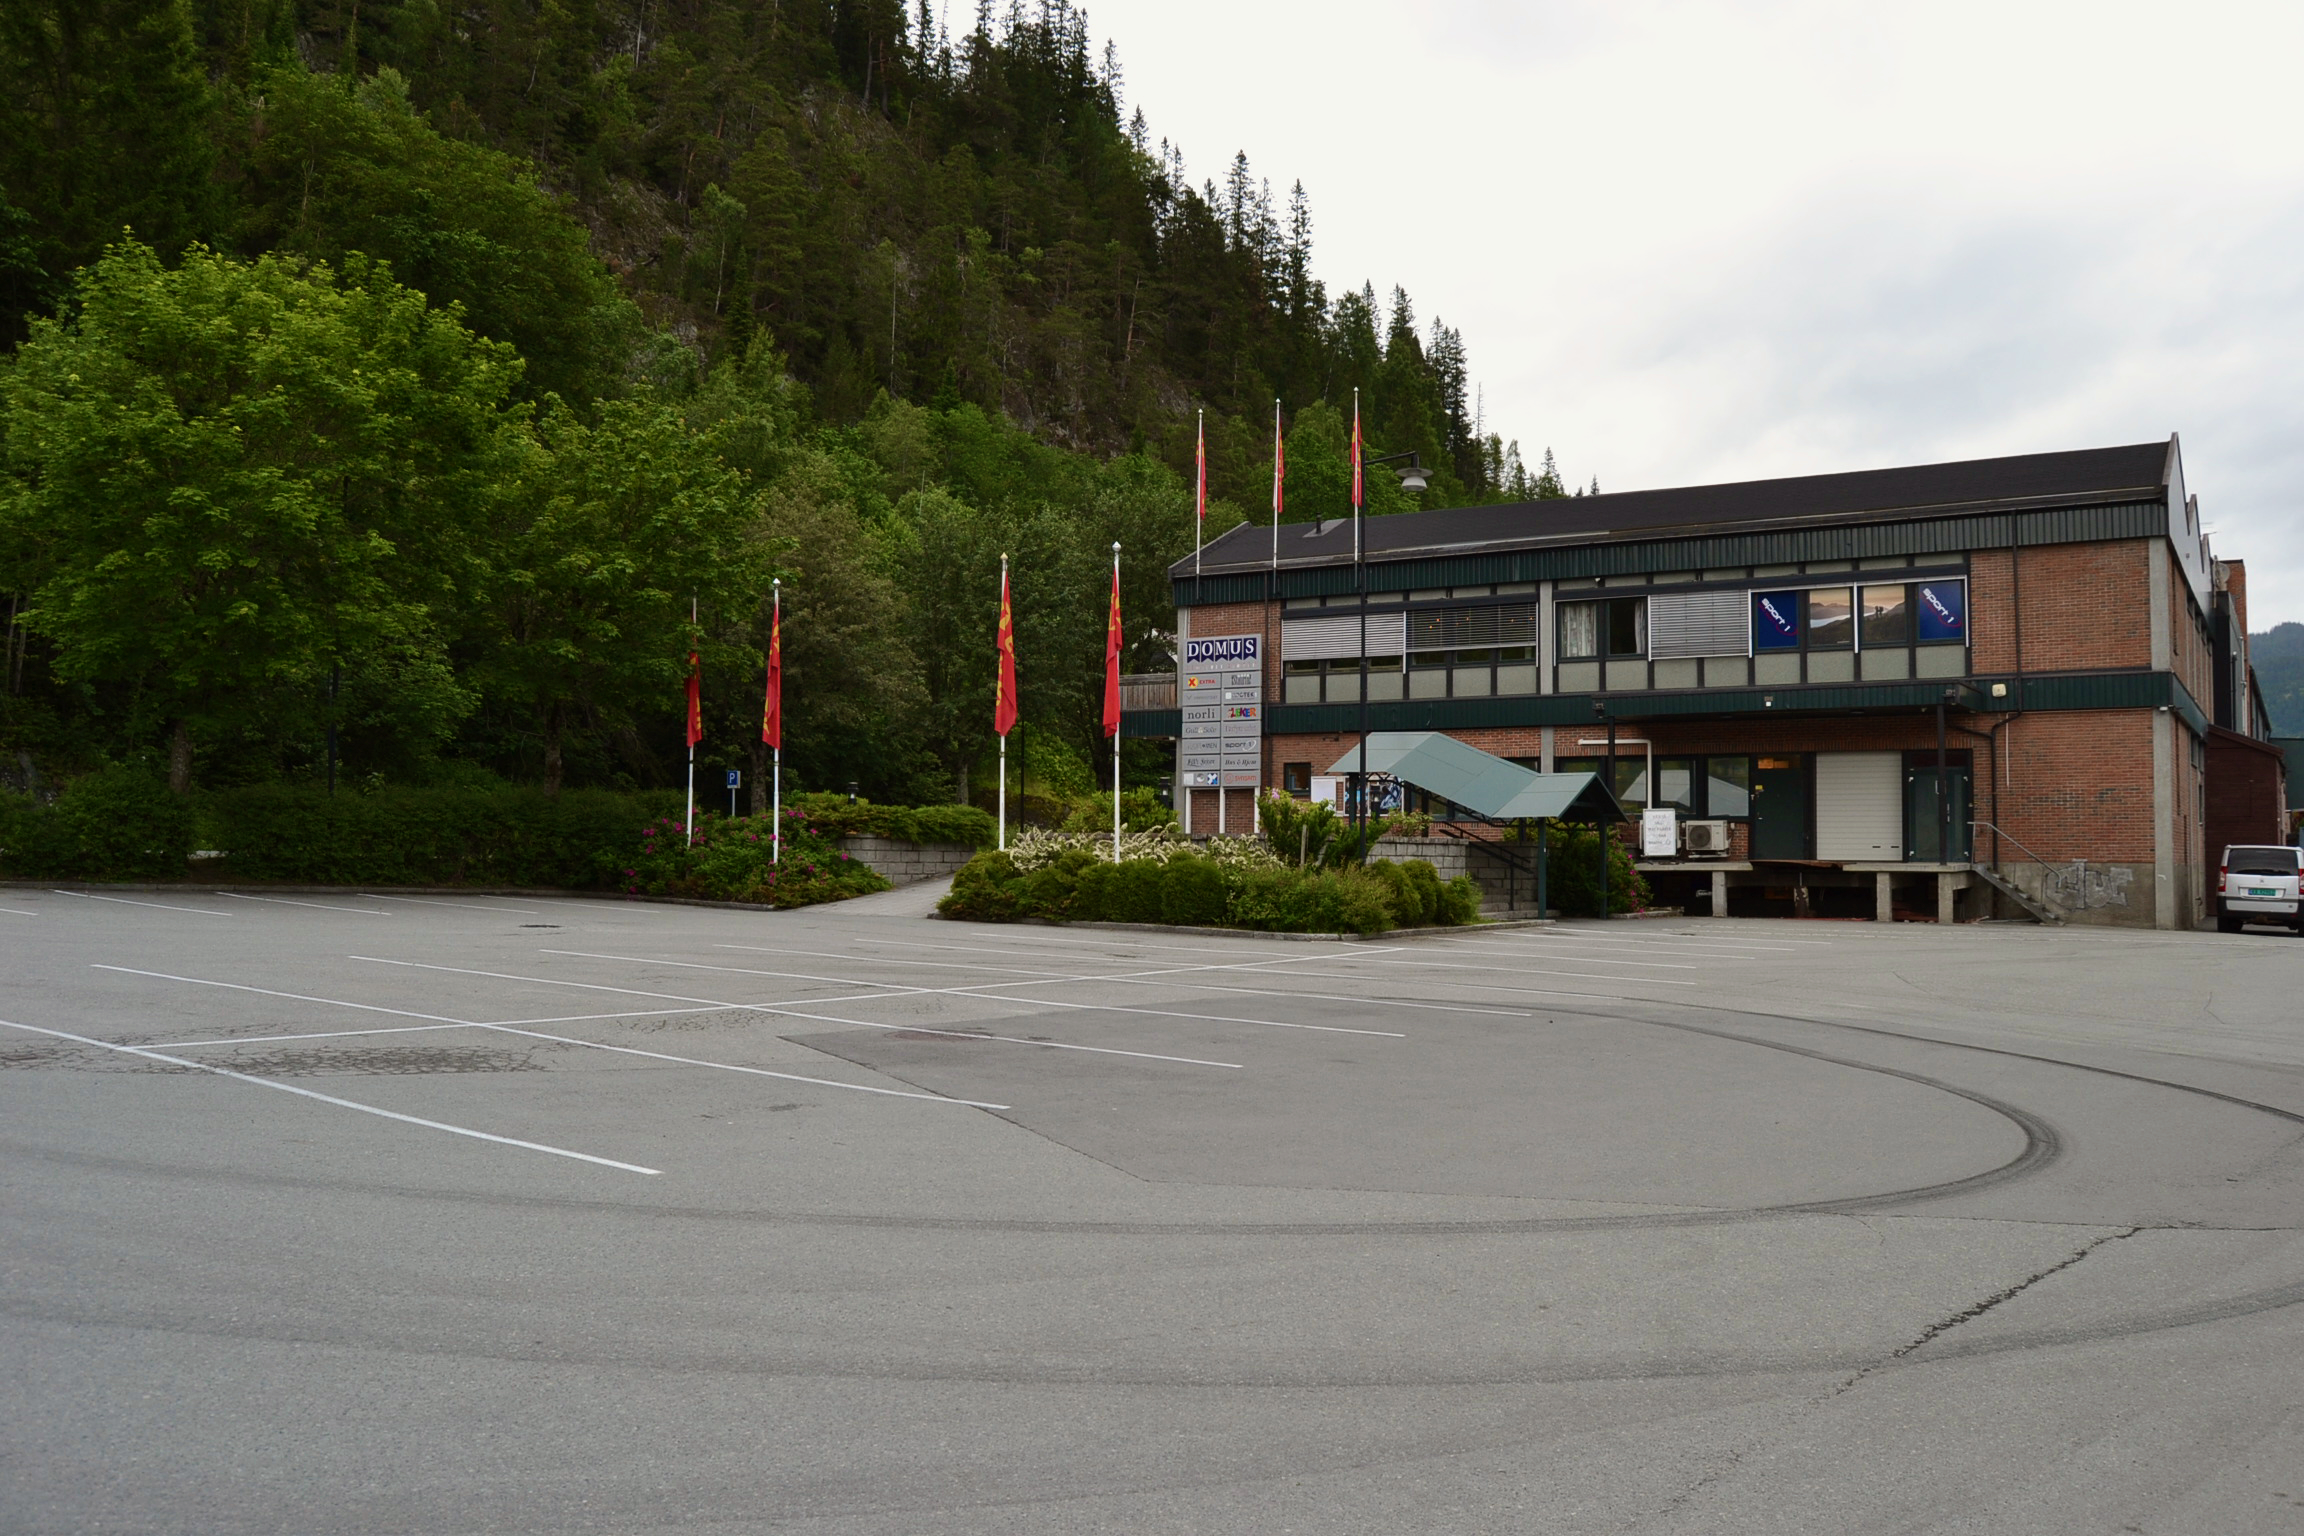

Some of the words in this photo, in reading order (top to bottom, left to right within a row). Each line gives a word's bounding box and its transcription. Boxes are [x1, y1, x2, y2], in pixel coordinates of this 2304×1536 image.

[1922, 587, 1949, 617] sport
[1761, 597, 1785, 625] sport
[1187, 639, 1254, 657] DOMUS
[1187, 708, 1215, 720] norli
[1230, 707, 1257, 718] LEKER
[1225, 741, 1247, 749] sport
